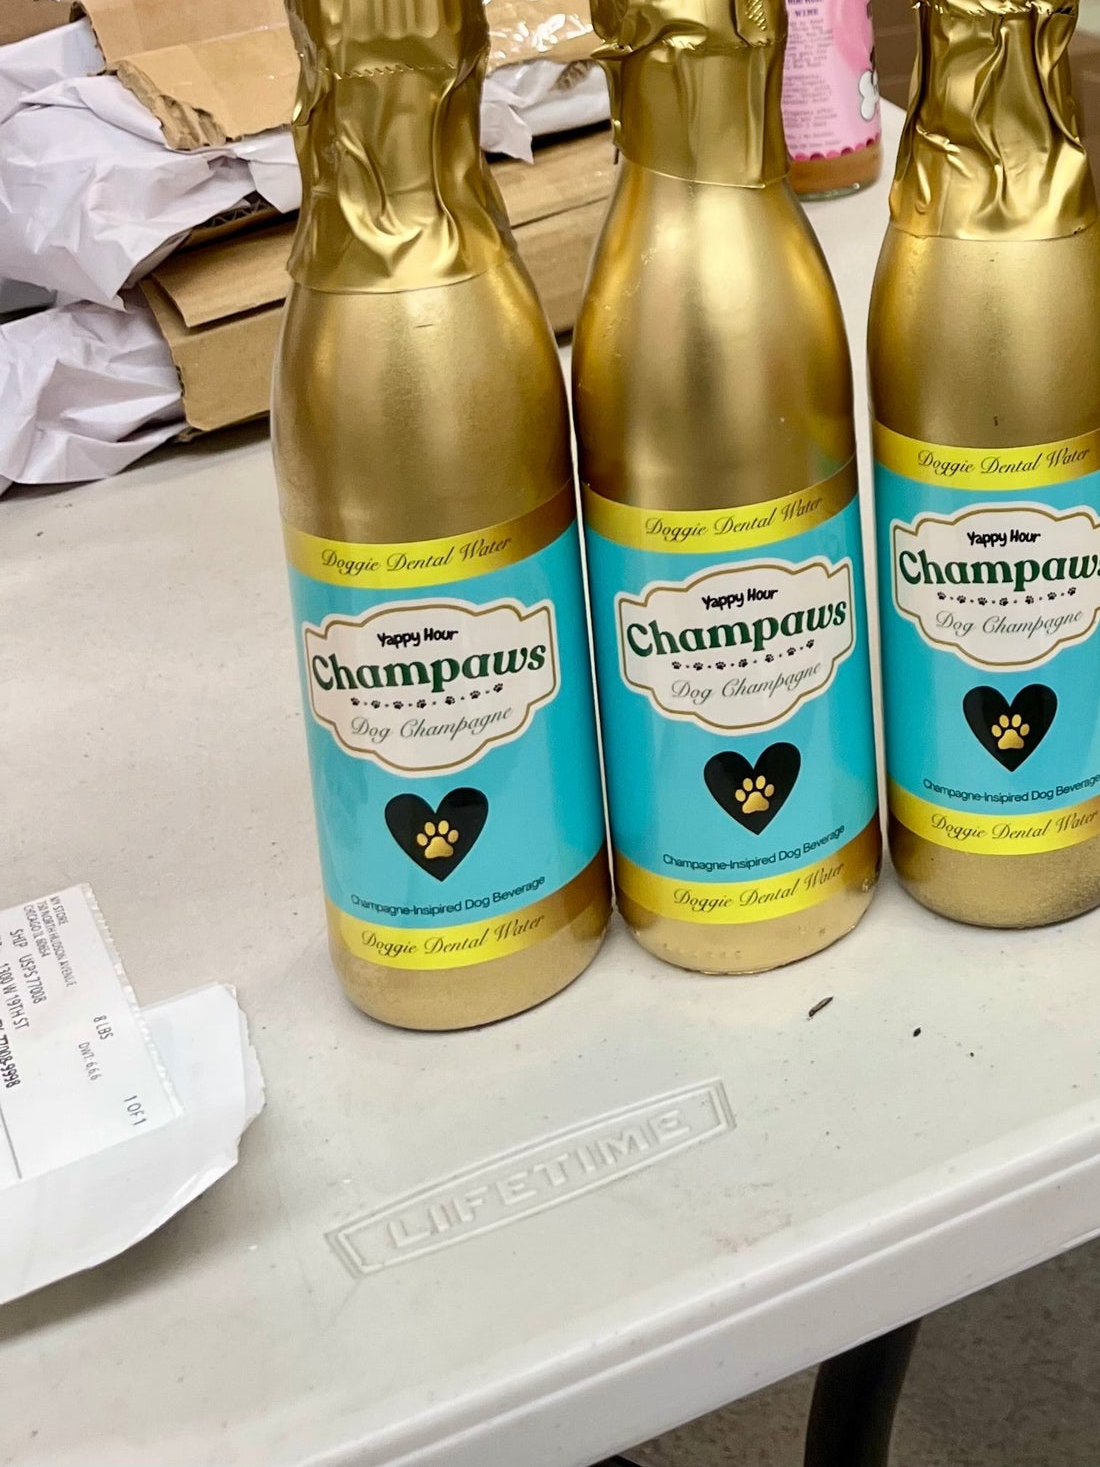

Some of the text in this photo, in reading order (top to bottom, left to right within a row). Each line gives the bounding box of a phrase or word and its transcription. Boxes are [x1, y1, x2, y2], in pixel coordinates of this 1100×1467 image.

[917, 445, 1091, 476] Doggie Dental Water
[645, 495, 823, 542] Doggie Dental Water
[966, 528, 1042, 548] Yappy Hour
[321, 535, 512, 577] Doggie Dental Water
[701, 587, 779, 610] Yappy Hour
[376, 628, 459, 649] Yappy Hour
[626, 599, 847, 657] Champaws
[935, 608, 1085, 640] Dog Champagne
[311, 643, 547, 694] Champaws
[670, 661, 822, 705] Dog Champagne
[350, 706, 513, 744] Dog Champagne
[1030, 787, 1055, 804] Dog
[1055, 774, 1100, 801] Beverage
[930, 809, 1100, 840] Doggie Dental Water
[777, 847, 802, 866] Dog
[802, 823, 846, 854] Beverage
[464, 894, 491, 913] Dog
[493, 873, 546, 905] Beverage
[673, 862, 845, 910] Doggie Dental Water
[24, 904, 42, 932] CHICAGO
[53, 905, 69, 926] STORE
[41, 910, 56, 934] NORTH
[49, 933, 66, 961] HUDSON
[60, 960, 77, 987] AVENUE
[361, 914, 546, 958] Doggie Dental Water
[9, 928, 47, 1005] SHIP USPS 77008
[2, 982, 18, 995] W
[5, 994, 25, 1019] 19TH
[13, 1017, 30, 1030] ST
[93, 1015, 114, 1040] 8 LBS
[123, 1095, 147, 1126] 1 OF 1
[386, 1109, 690, 1249] LIFETIME
